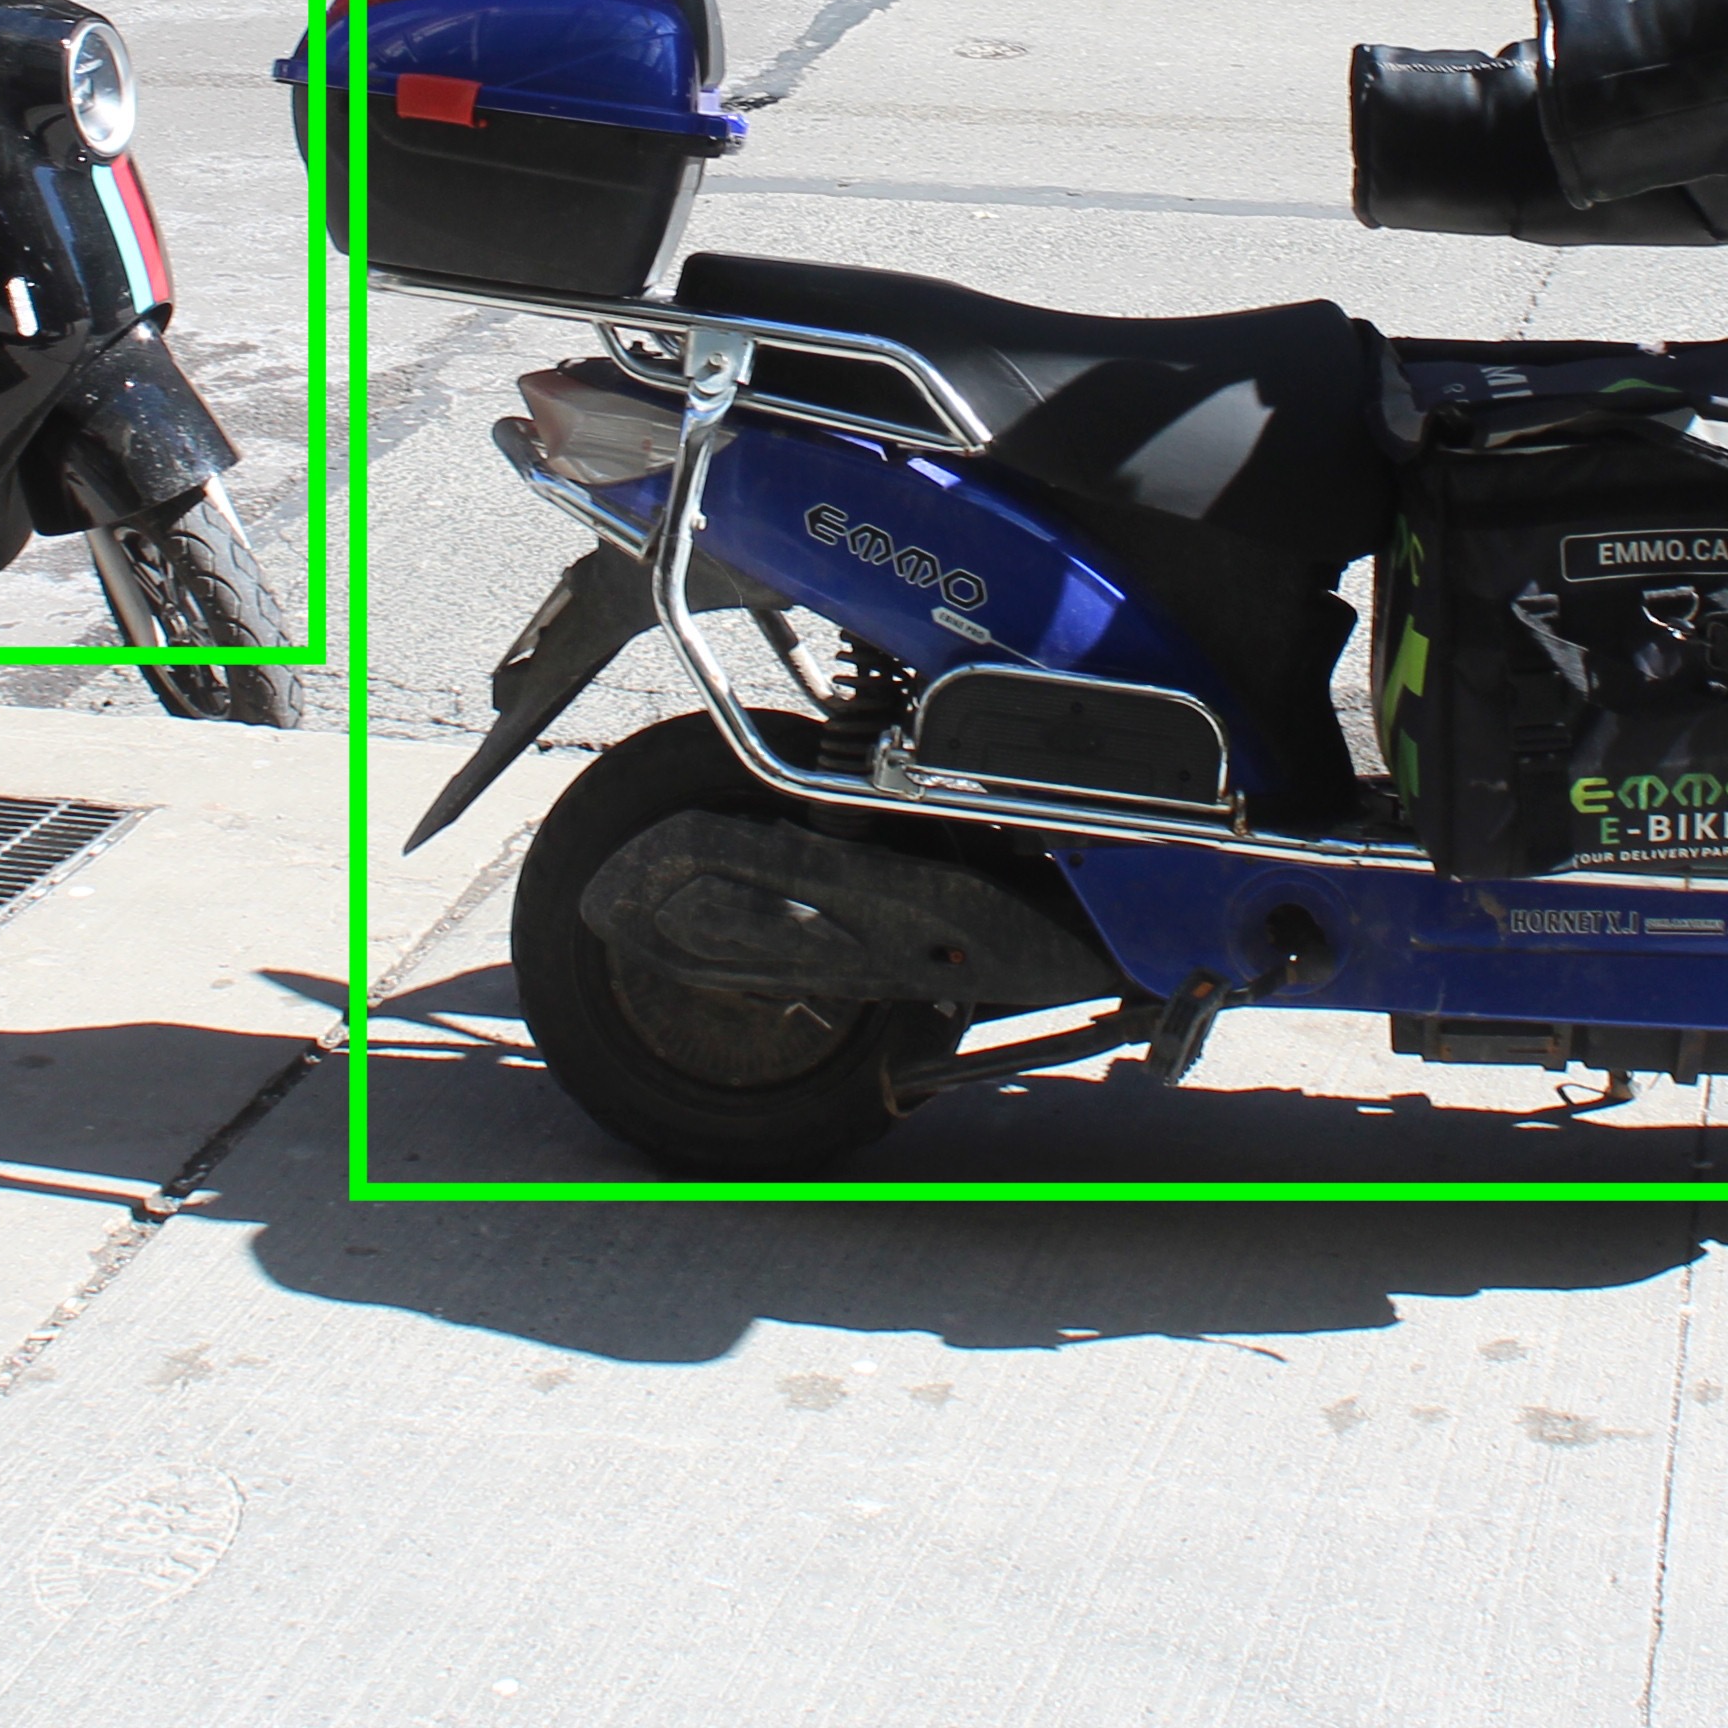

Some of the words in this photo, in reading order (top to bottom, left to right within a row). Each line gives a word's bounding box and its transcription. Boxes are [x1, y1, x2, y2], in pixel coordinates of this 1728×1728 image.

[804, 502, 989, 611] EMMO
[1620, 846, 1700, 863] DELIVERY
[1510, 909, 1603, 934] HORNET
